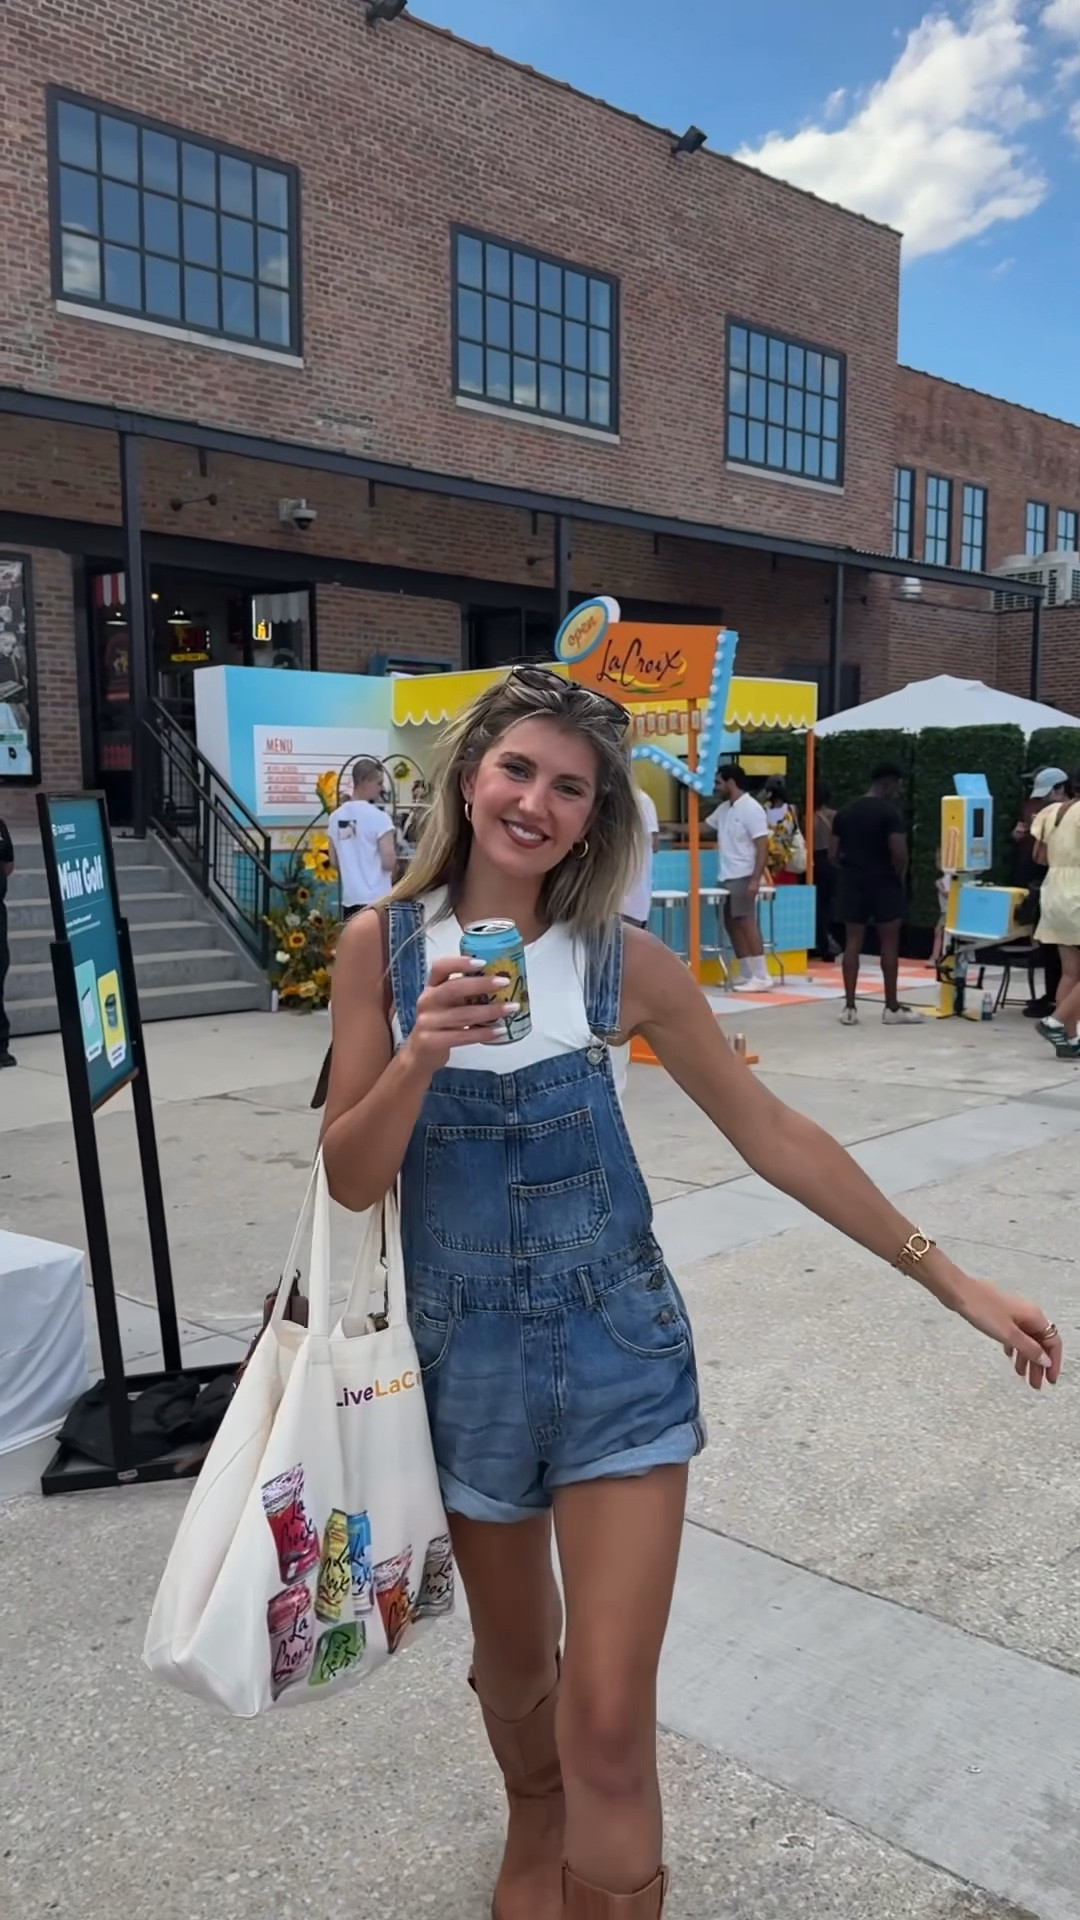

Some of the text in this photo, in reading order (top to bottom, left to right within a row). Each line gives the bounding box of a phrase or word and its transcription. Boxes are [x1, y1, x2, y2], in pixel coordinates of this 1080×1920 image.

[568, 615, 596, 649] open
[266, 738, 293, 752] MENU
[58, 854, 104, 901] Mini Golf
